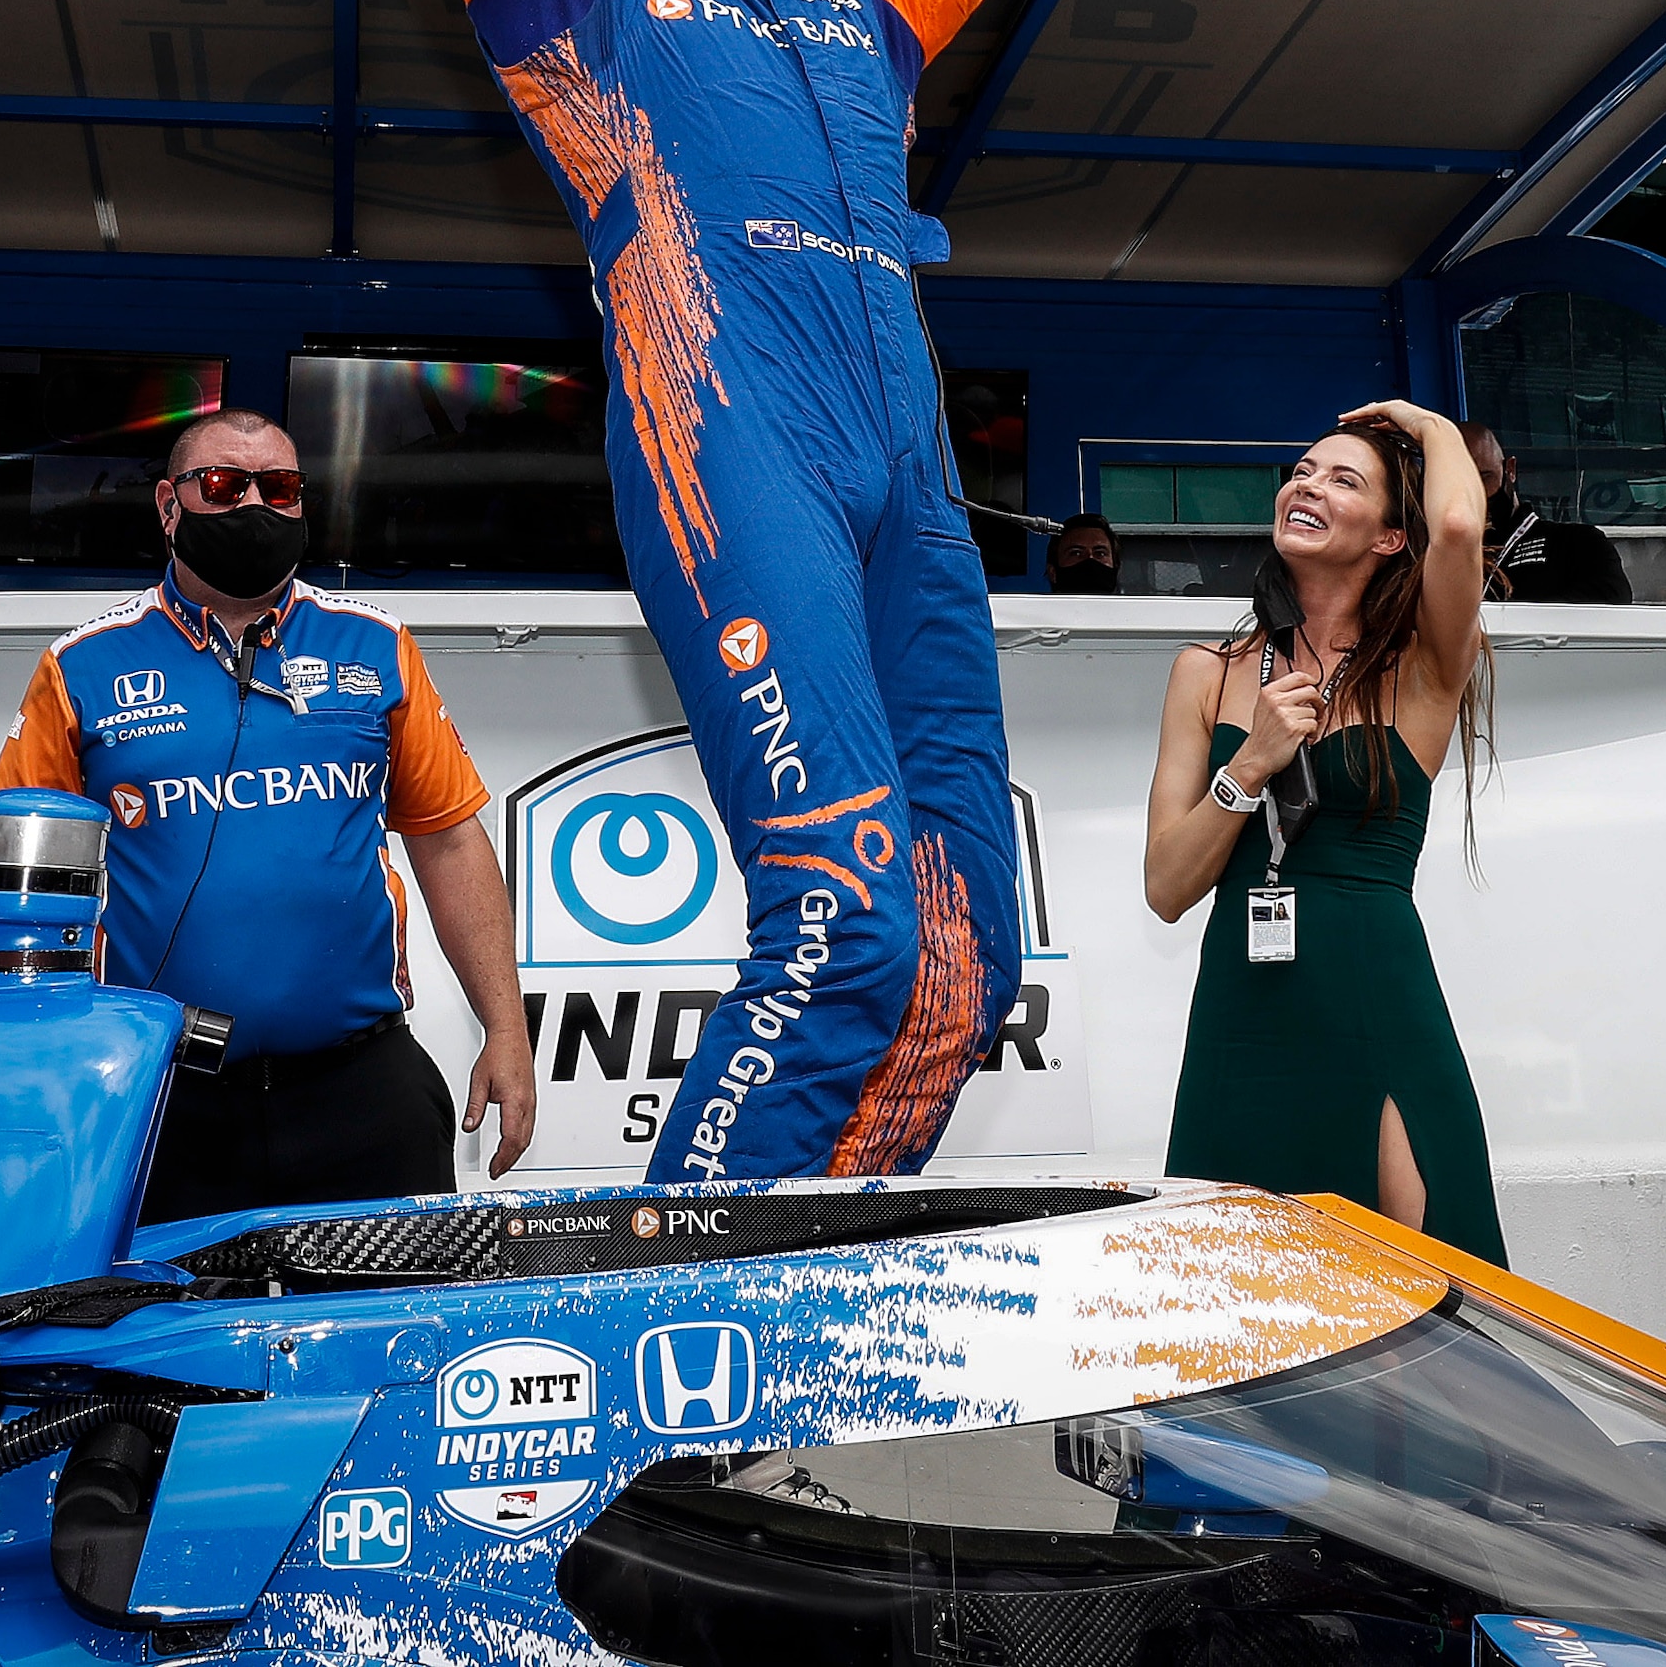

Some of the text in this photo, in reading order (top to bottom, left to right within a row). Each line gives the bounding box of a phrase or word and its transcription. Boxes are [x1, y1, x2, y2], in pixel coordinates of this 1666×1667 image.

[281, 673, 329, 685] IDYCAR
[302, 663, 323, 672] NTT
[94, 702, 189, 731] HONDA
[118, 720, 188, 742] CARVANA
[739, 668, 809, 802] PNC
[683, 1045, 776, 1181] Great
[665, 1208, 731, 1236] PNC
[509, 1373, 582, 1406] NTT
[436, 1424, 597, 1466] INDYCAR
[468, 1458, 562, 1483] SERIES
[325, 1498, 407, 1562] PPG
